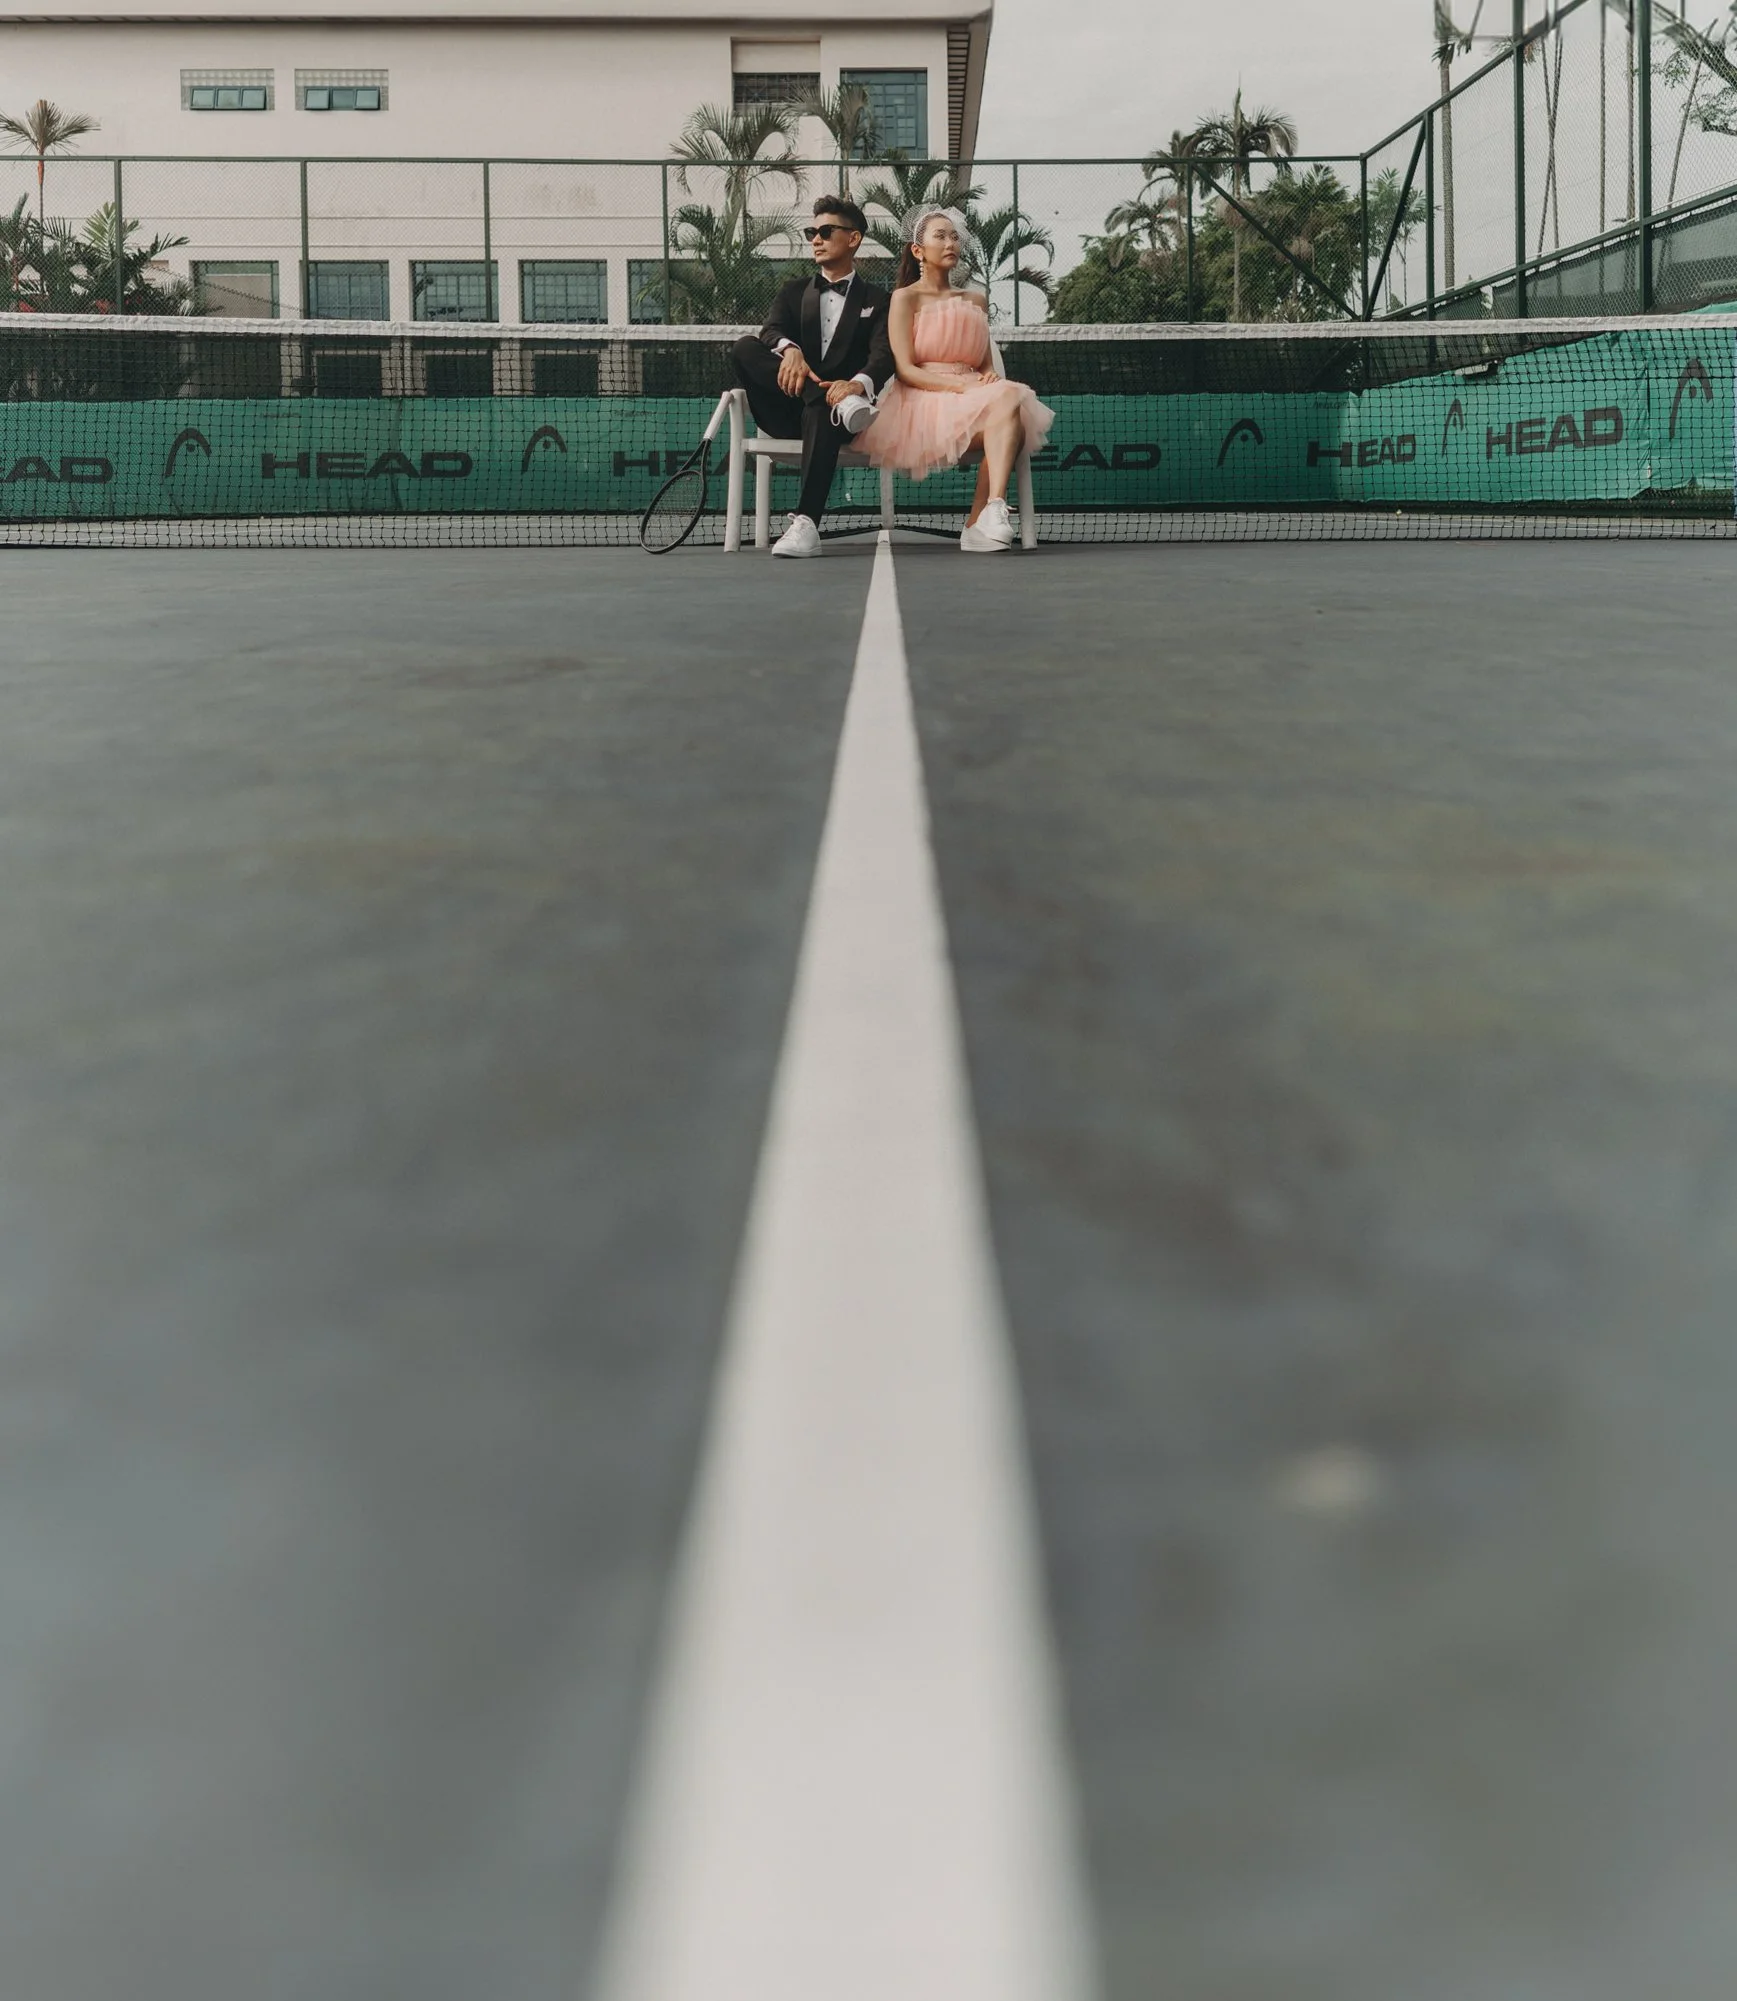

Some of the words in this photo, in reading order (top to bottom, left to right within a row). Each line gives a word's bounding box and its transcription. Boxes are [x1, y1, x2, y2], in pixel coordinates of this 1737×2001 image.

[1486, 405, 1623, 459] HEAD
[262, 452, 473, 478] HEAD
[959, 444, 1162, 473] EAD
[1307, 434, 1416, 467] HEAD
[0, 456, 114, 484] AD
